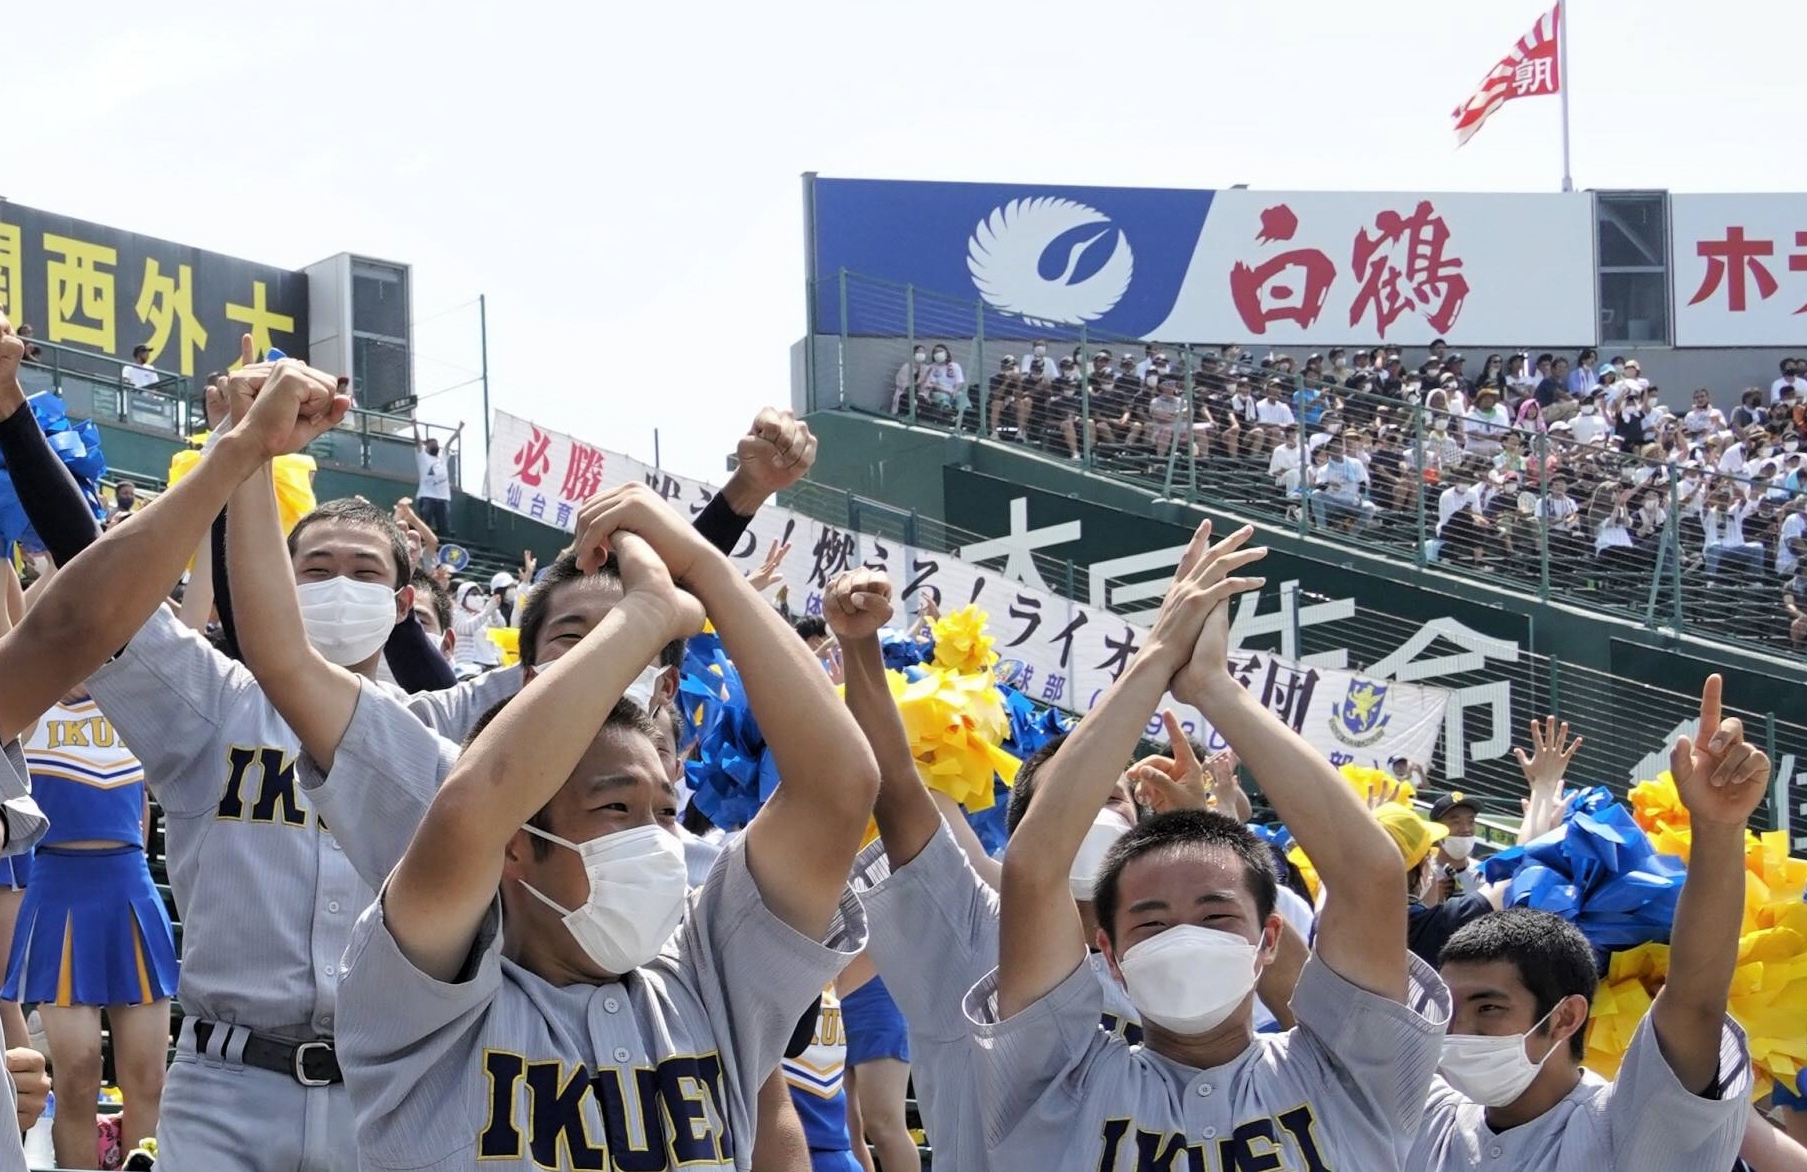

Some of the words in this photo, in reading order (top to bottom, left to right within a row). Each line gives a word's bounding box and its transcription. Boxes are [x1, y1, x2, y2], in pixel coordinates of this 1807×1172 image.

[1229, 200, 1471, 339] 白鶴
[510, 424, 605, 503] 必勝
[46, 715, 126, 749] IKU
[216, 744, 331, 831] IK
